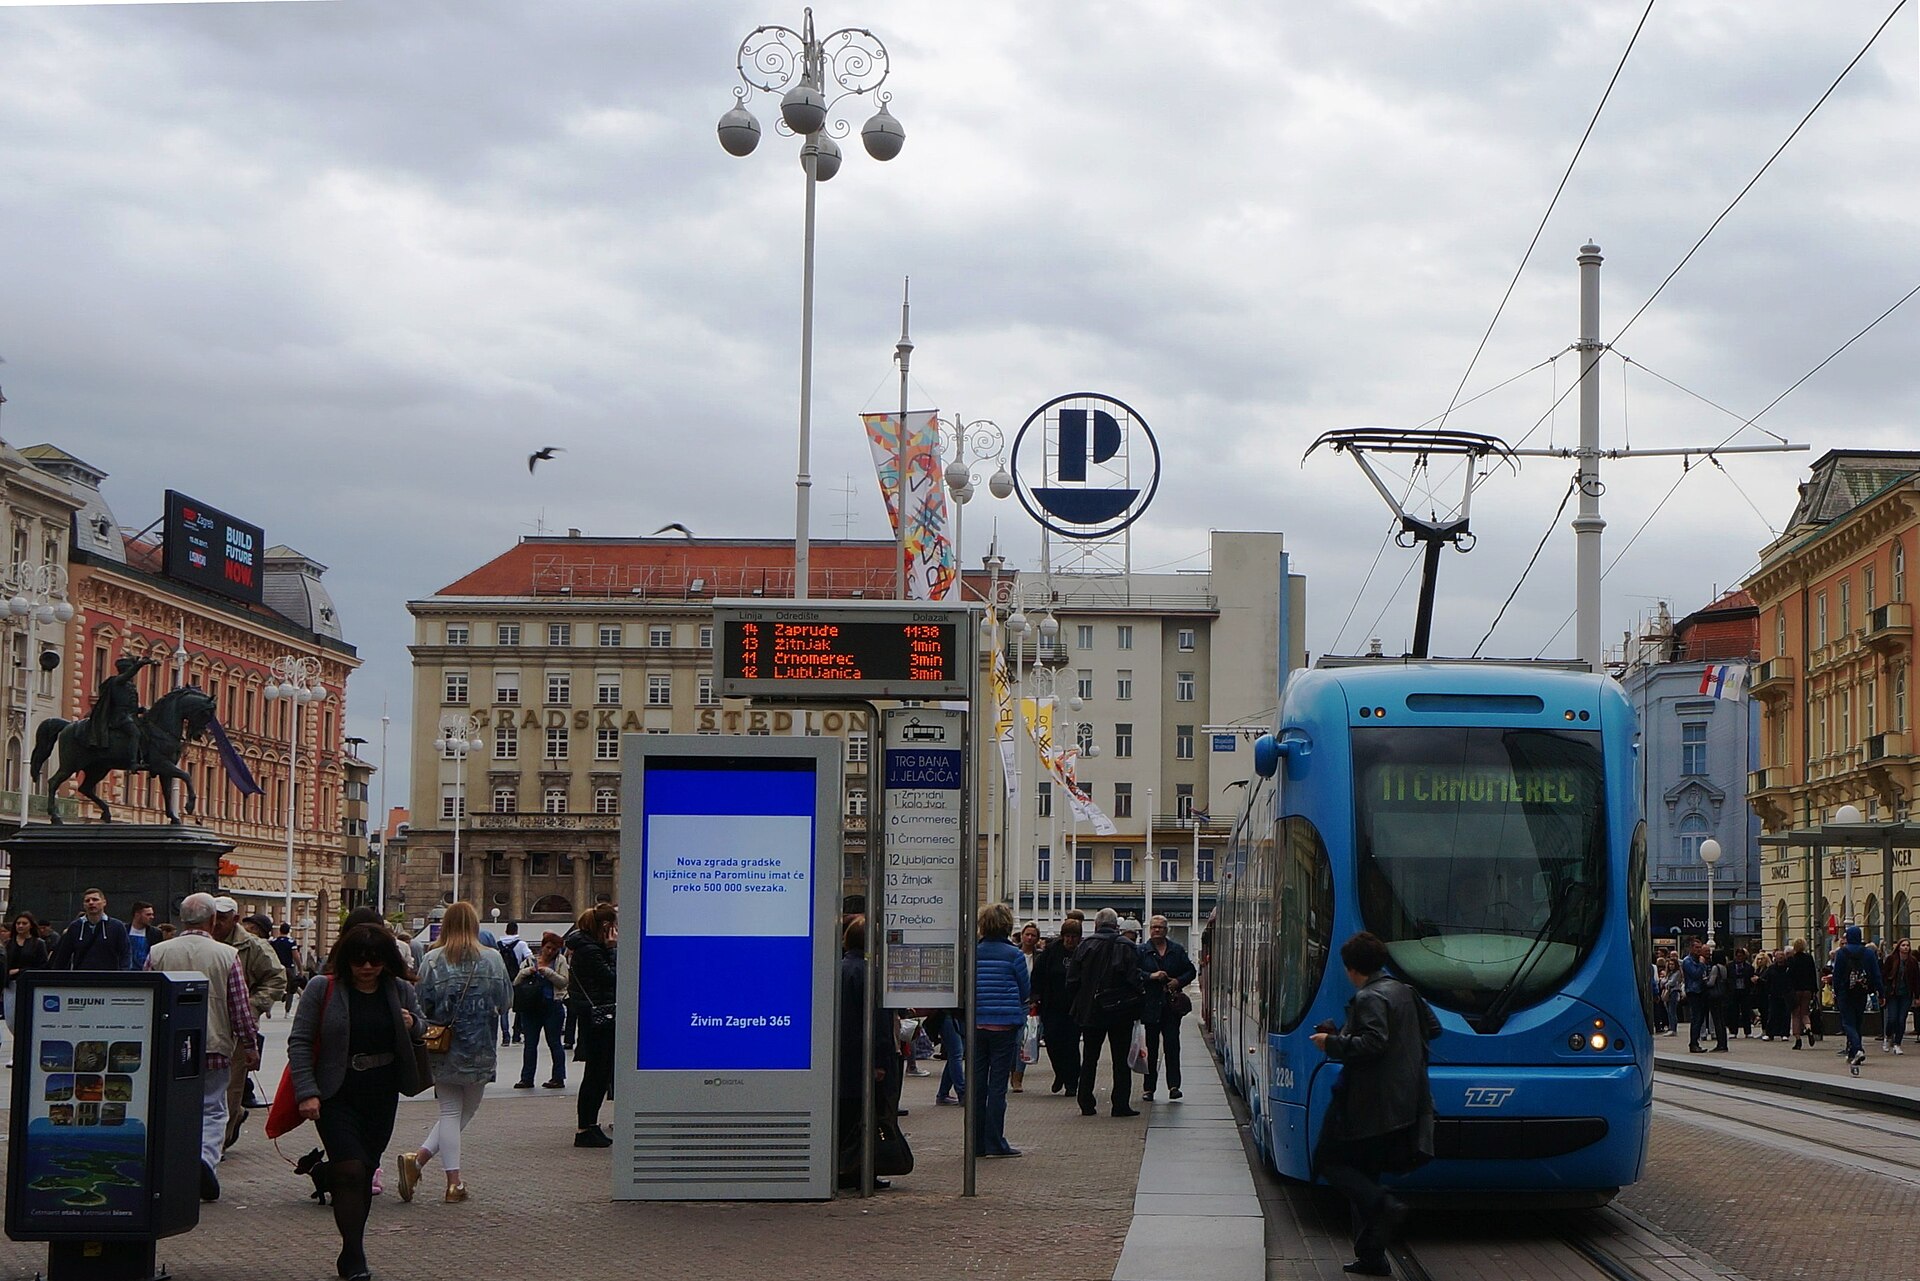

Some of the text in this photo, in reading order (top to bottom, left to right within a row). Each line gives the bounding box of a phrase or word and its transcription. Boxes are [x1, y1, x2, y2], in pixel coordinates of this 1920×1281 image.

[226, 526, 253, 550] BUILD
[225, 545, 253, 566] FUTURE
[225, 559, 253, 588] NOW.
[739, 611, 949, 622] Linija Odredište Dolazak
[742, 623, 758, 636] 14
[904, 625, 940, 638] 11:38
[742, 637, 941, 652] 13 Žitnjak 1min
[742, 651, 943, 667] 11 Črnomerec 3min
[742, 665, 943, 681] 12 Ljubljanica 3min
[470, 708, 868, 731] GRADSKA ŠTEDION
[895, 755, 950, 767] TRG BANA
[890, 770, 899, 781] J.
[1380, 765, 1405, 801] 11
[894, 793, 899, 806] 1
[891, 815, 899, 825] 6
[885, 832, 956, 845] 11 Črnomerec
[677, 857, 781, 868] Nova zgrada gradske
[889, 853, 955, 866] 12 Ljubljanica
[1892, 849, 1912, 867] NGER
[653, 870, 697, 880] knjižnice
[715, 870, 766, 879] Paromlinu
[769, 871, 792, 879] imat
[793, 871, 805, 880] će
[886, 872, 933, 886] 13 Žitnjak
[1771, 864, 1790, 880] SINGER
[672, 883, 788, 893] preko 500 000 svezaka.
[886, 893, 898, 906] 14
[885, 913, 933, 926] 17 Prečko
[1682, 917, 1723, 928] iNovne
[67, 997, 105, 1007] BRIJUNI
[691, 1012, 791, 1028] Živim Zagreb 365
[1275, 1067, 1294, 1089] 2284
[1464, 1087, 1516, 1108] ZET
